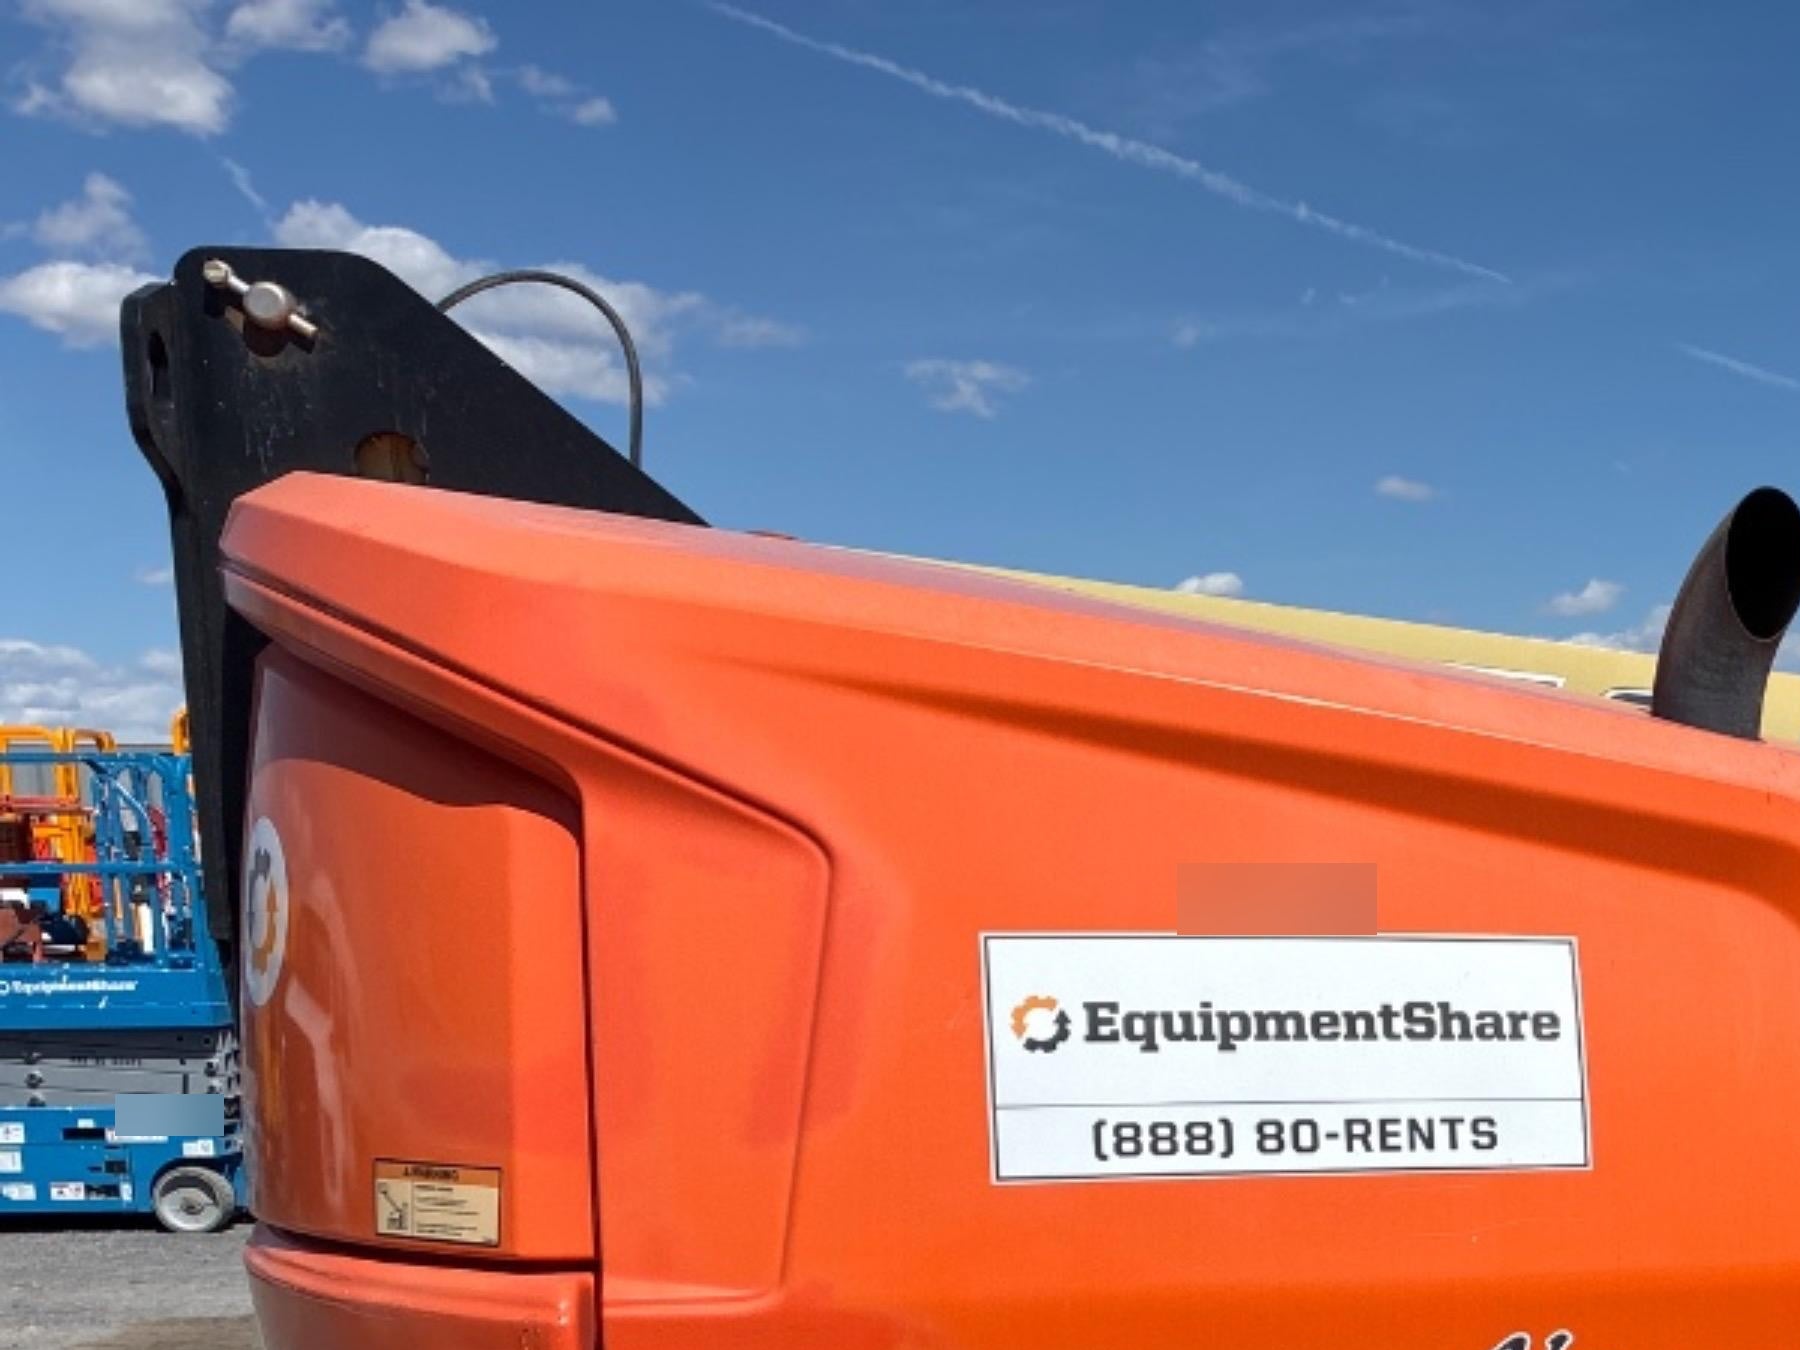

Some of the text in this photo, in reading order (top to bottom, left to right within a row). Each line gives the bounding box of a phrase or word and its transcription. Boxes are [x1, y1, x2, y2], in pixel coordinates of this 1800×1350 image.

[1083, 1000, 1561, 1052] EquipmentShare
[1092, 1116, 1499, 1162] (888) 80-RENTS
